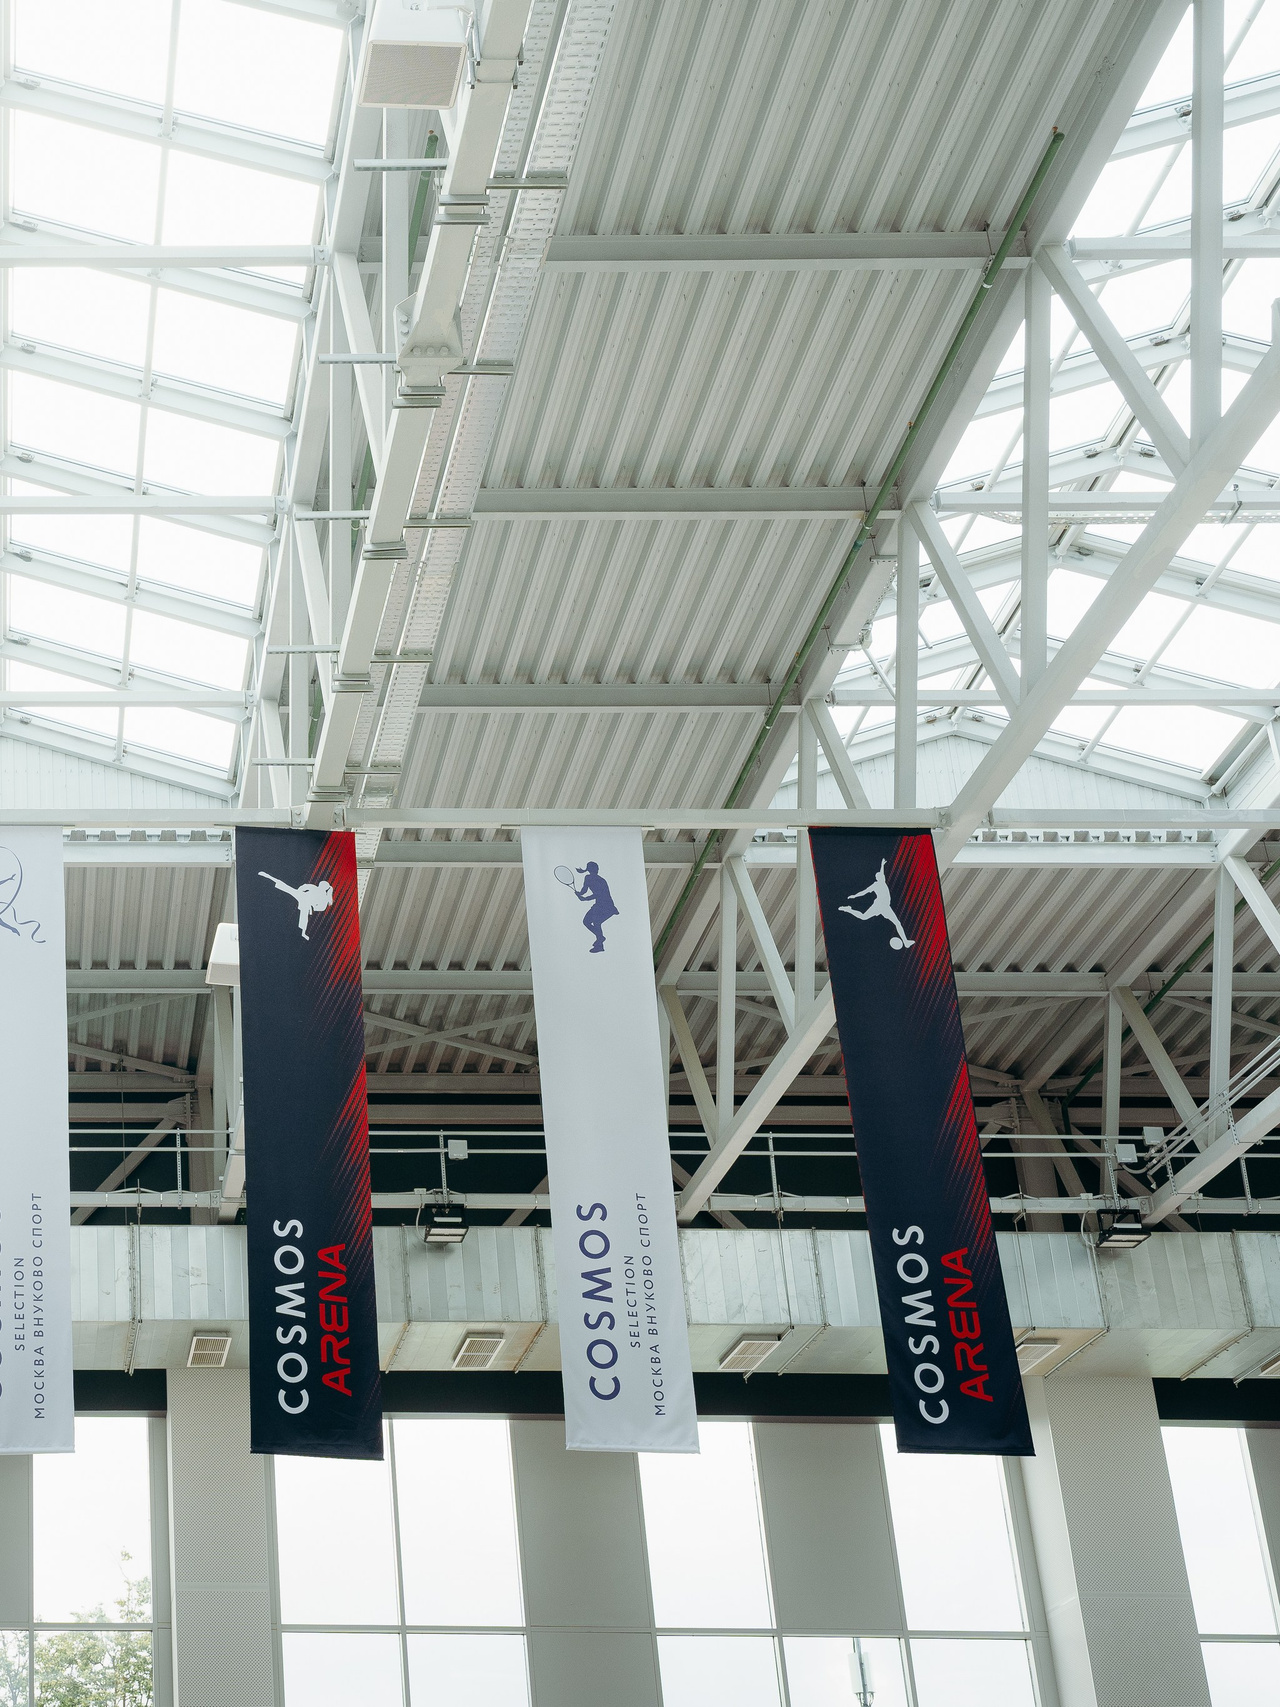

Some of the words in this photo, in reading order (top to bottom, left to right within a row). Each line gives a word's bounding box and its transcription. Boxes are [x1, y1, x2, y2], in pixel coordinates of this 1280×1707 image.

[32, 1193, 42, 1248] СПОРТ
[636, 1193, 650, 1247] СПОРТ
[14, 1258, 25, 1351] SELECTION
[33, 1257, 44, 1337] ВНУКОВО
[273, 1220, 309, 1414] COSMOS
[318, 1244, 351, 1396] ARENA
[576, 1203, 620, 1400] COSMOS
[624, 1256, 640, 1348] SELECTION
[642, 1256, 658, 1335] ВНУКОВО
[892, 1226, 949, 1424] COSMOS
[941, 1248, 993, 1401] ARENA
[34, 1346, 45, 1418] МОСКВА
[649, 1344, 665, 1415] МОСКВА
